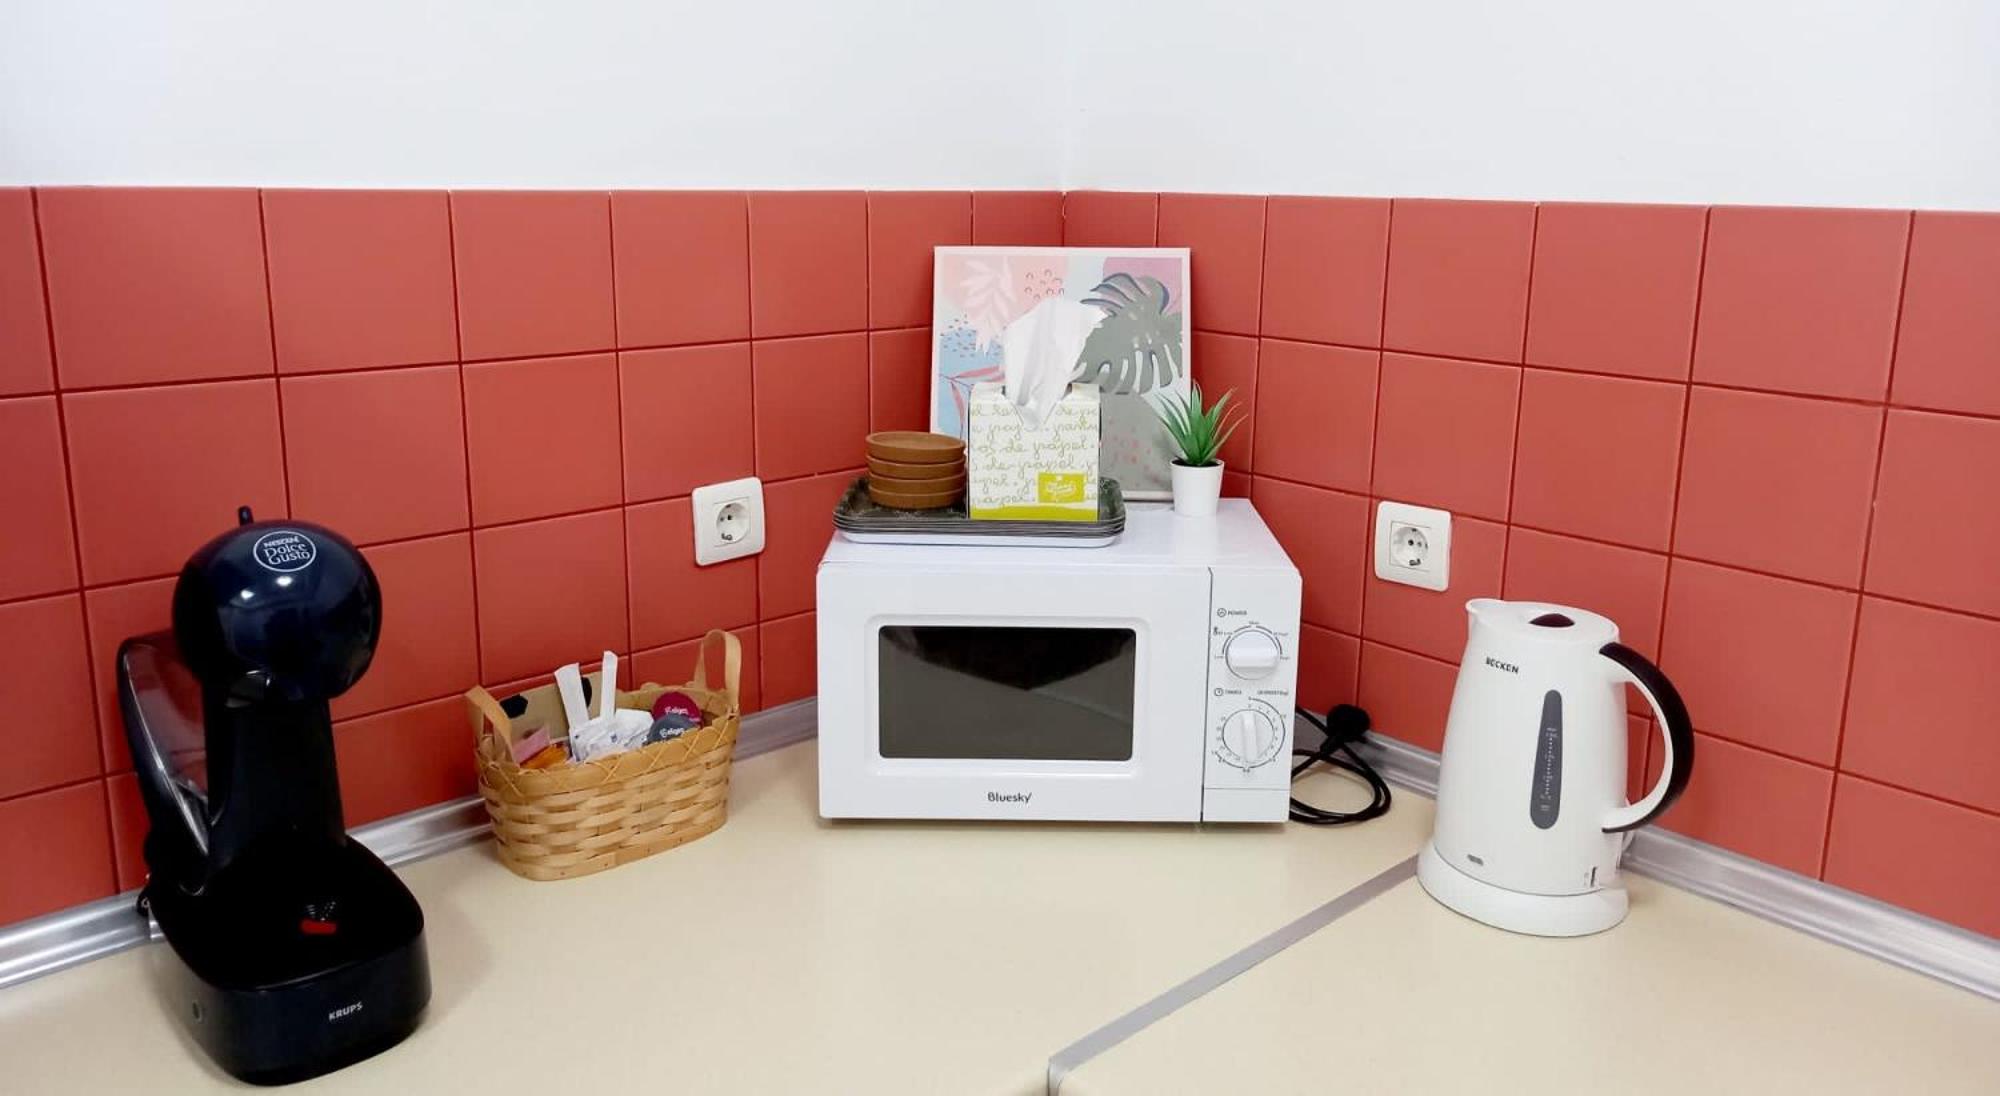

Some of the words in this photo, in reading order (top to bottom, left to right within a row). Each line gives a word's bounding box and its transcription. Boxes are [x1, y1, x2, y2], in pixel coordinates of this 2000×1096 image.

[263, 543, 307, 558] Dolce
[268, 551, 311, 565] Gusto
[1485, 656, 1520, 675] BECKEN
[987, 791, 1032, 804] Bluesky
[328, 1001, 363, 1021] KRUPS
